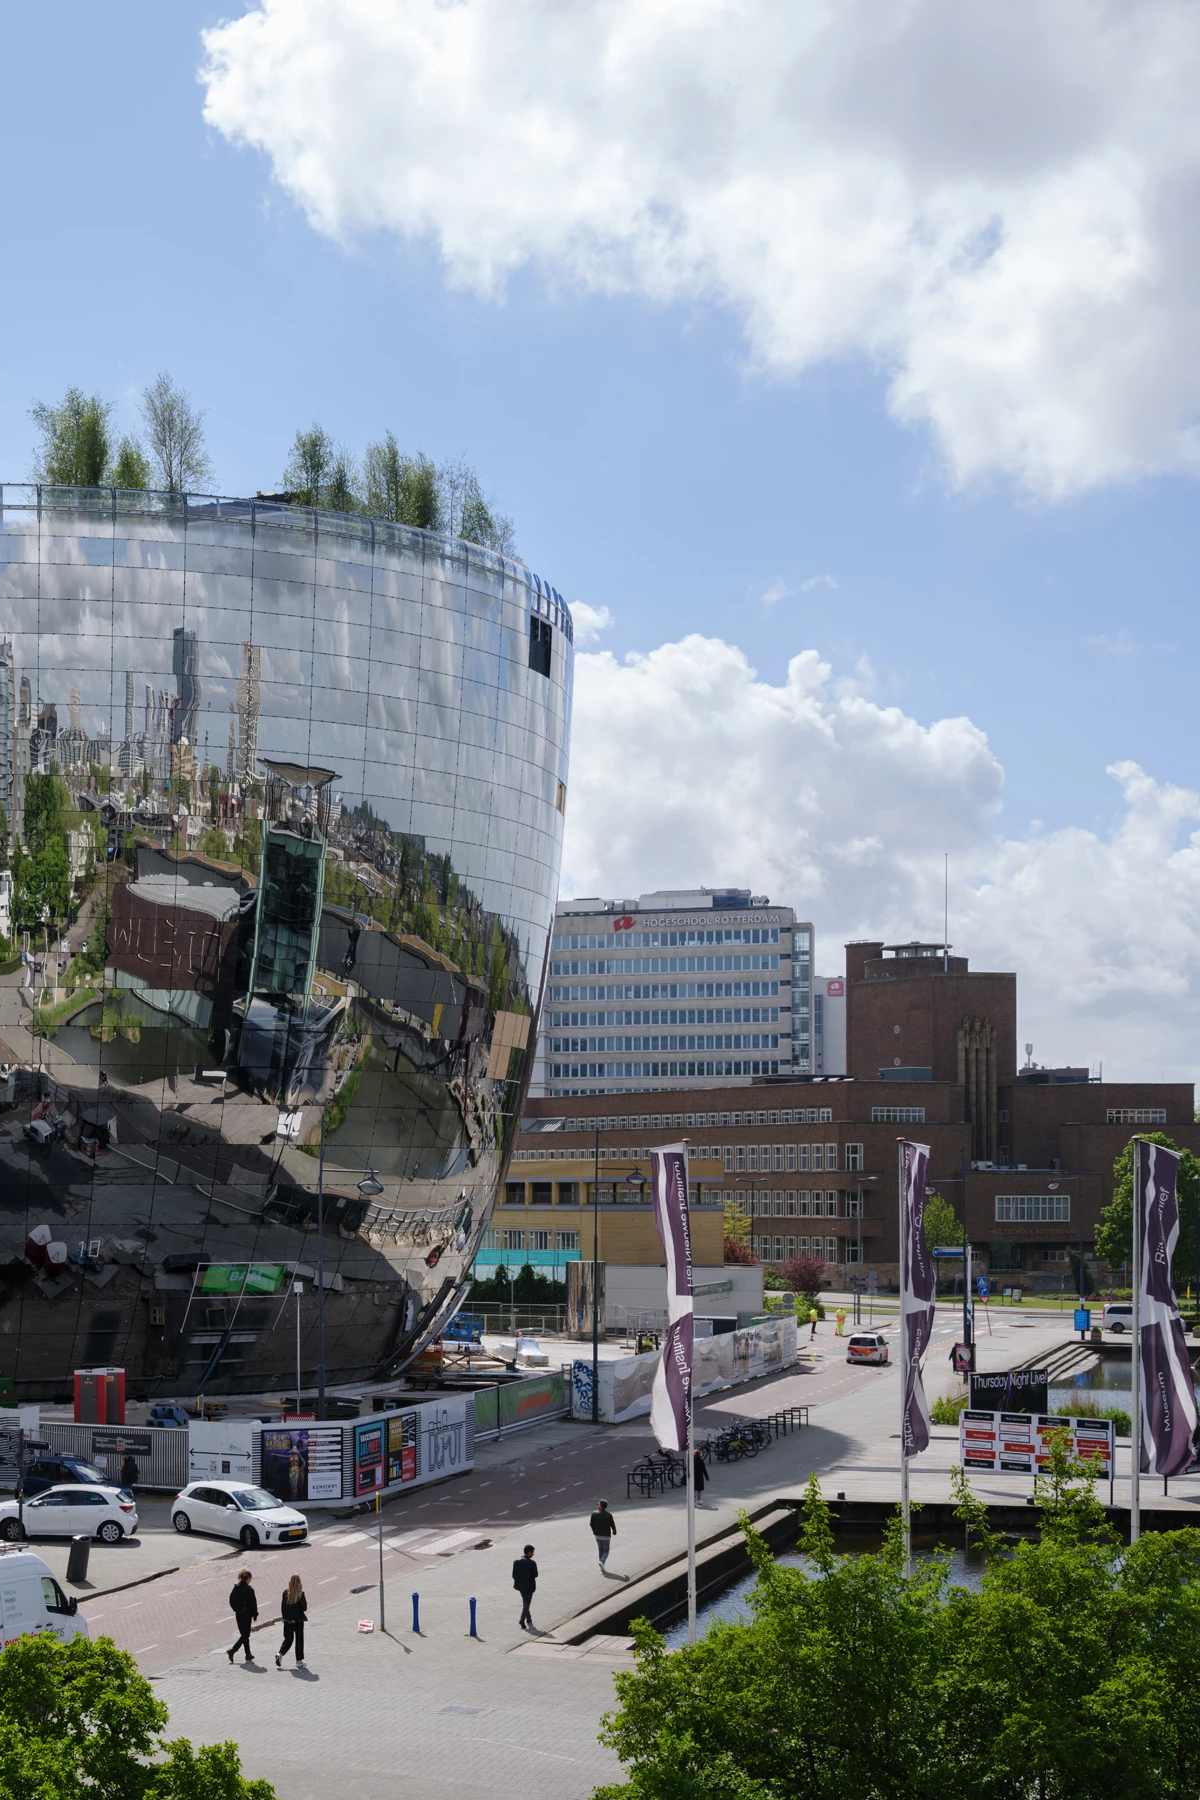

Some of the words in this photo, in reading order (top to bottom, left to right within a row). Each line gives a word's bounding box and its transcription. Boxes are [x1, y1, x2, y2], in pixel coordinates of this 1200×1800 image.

[643, 916, 712, 927] HOGESCHOOL
[714, 914, 780, 924] ROTTERDAM
[973, 1374, 1008, 1389] Thursday
[1010, 1373, 1029, 1389] Night
[1030, 1371, 1047, 1384] Live!
[1158, 1372, 1171, 1432] Museum
